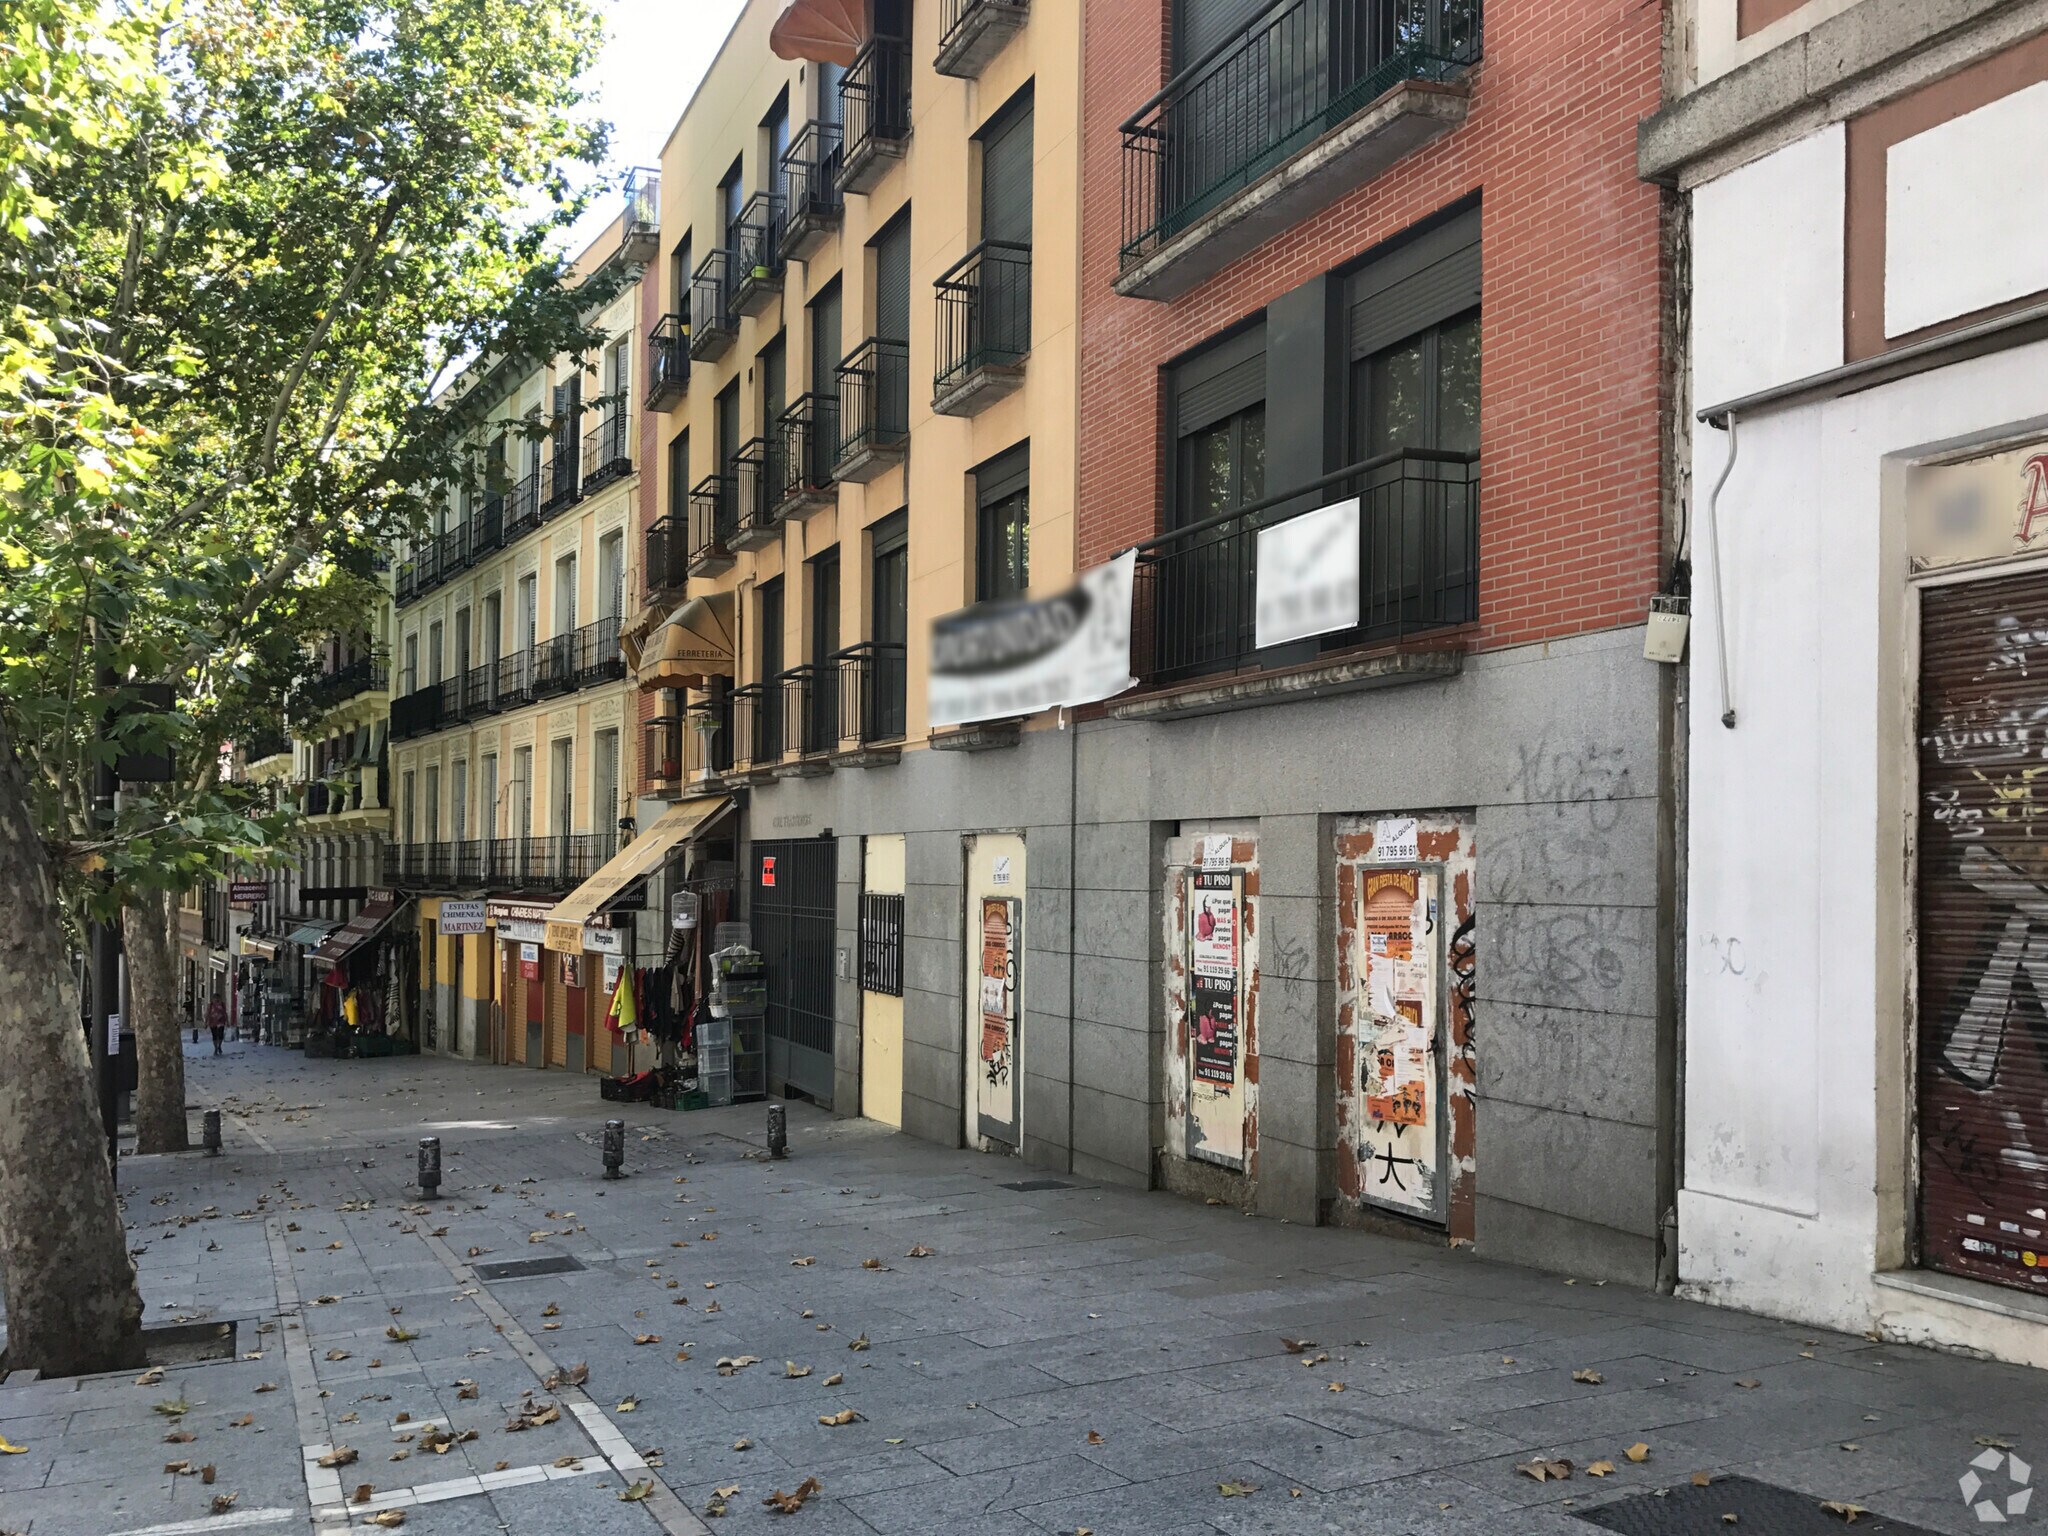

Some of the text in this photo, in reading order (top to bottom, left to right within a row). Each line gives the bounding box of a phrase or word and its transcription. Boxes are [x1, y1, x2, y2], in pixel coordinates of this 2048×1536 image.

[678, 650, 722, 658] FERRETERIA
[1392, 820, 1415, 842] ALQUILA
[1378, 844, 1416, 857] 91 795 98 61
[1203, 874, 1230, 886] TU PISO
[444, 922, 484, 931] MARTINEZ
[1204, 978, 1231, 991] TU PISO
